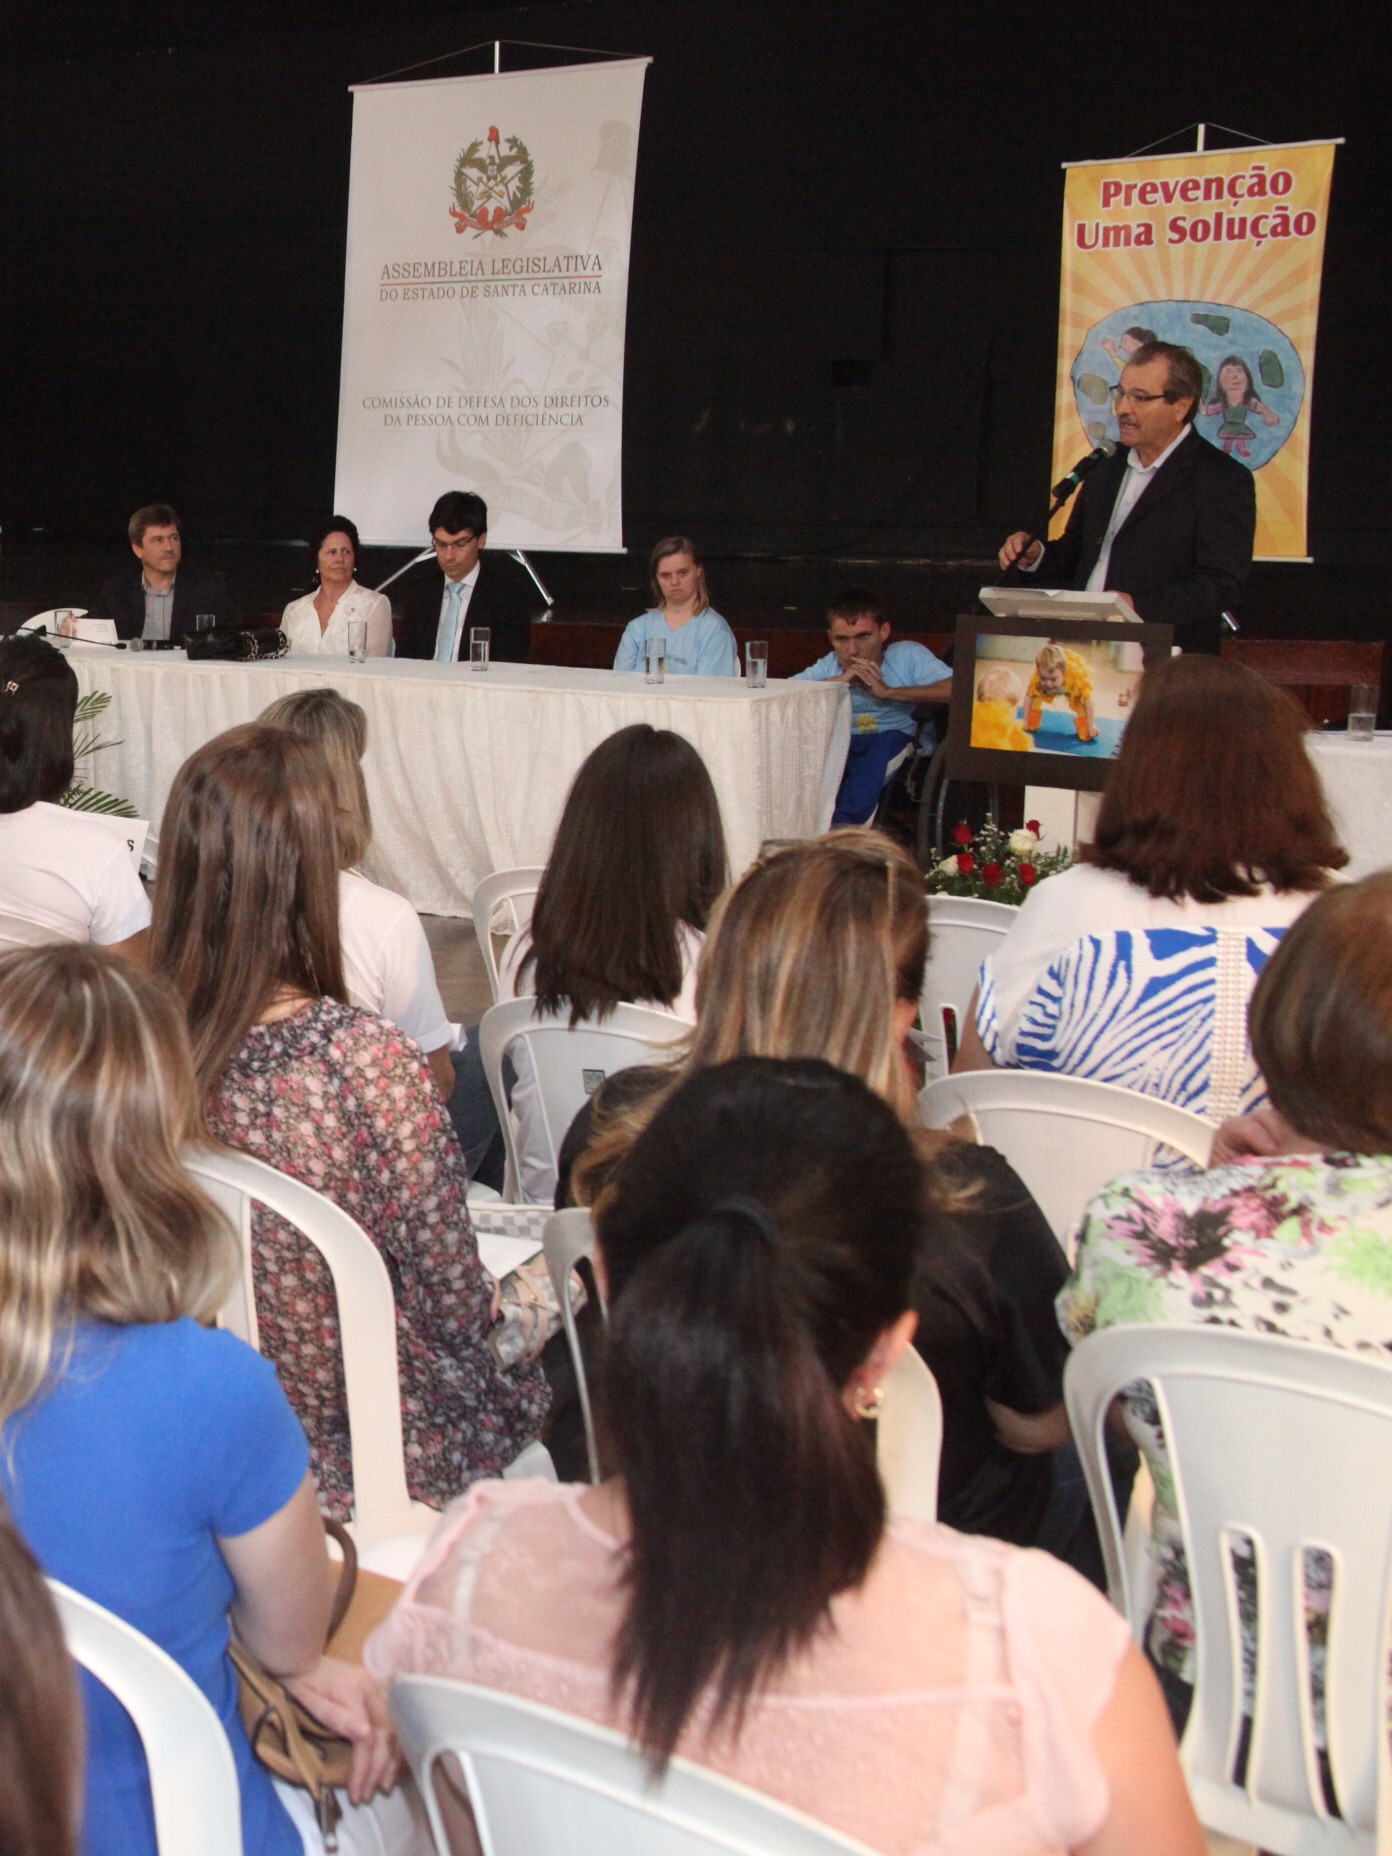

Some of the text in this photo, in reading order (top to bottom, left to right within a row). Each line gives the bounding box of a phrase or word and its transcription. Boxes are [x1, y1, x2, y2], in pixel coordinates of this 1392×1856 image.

[1101, 165, 1293, 208] Prevenção
[1075, 205, 1317, 250] Uma Solução
[380, 254, 603, 280] ASSEMBLEIA LEGISLATIVA
[379, 281, 602, 301] DO ESTADO DE SANTA CATARINA
[362, 394, 610, 410] COMISSÃO DE DEFESA DOS DIREITOS
[383, 411, 584, 426] DA PESSOA COM DEFICIÊNCIA
